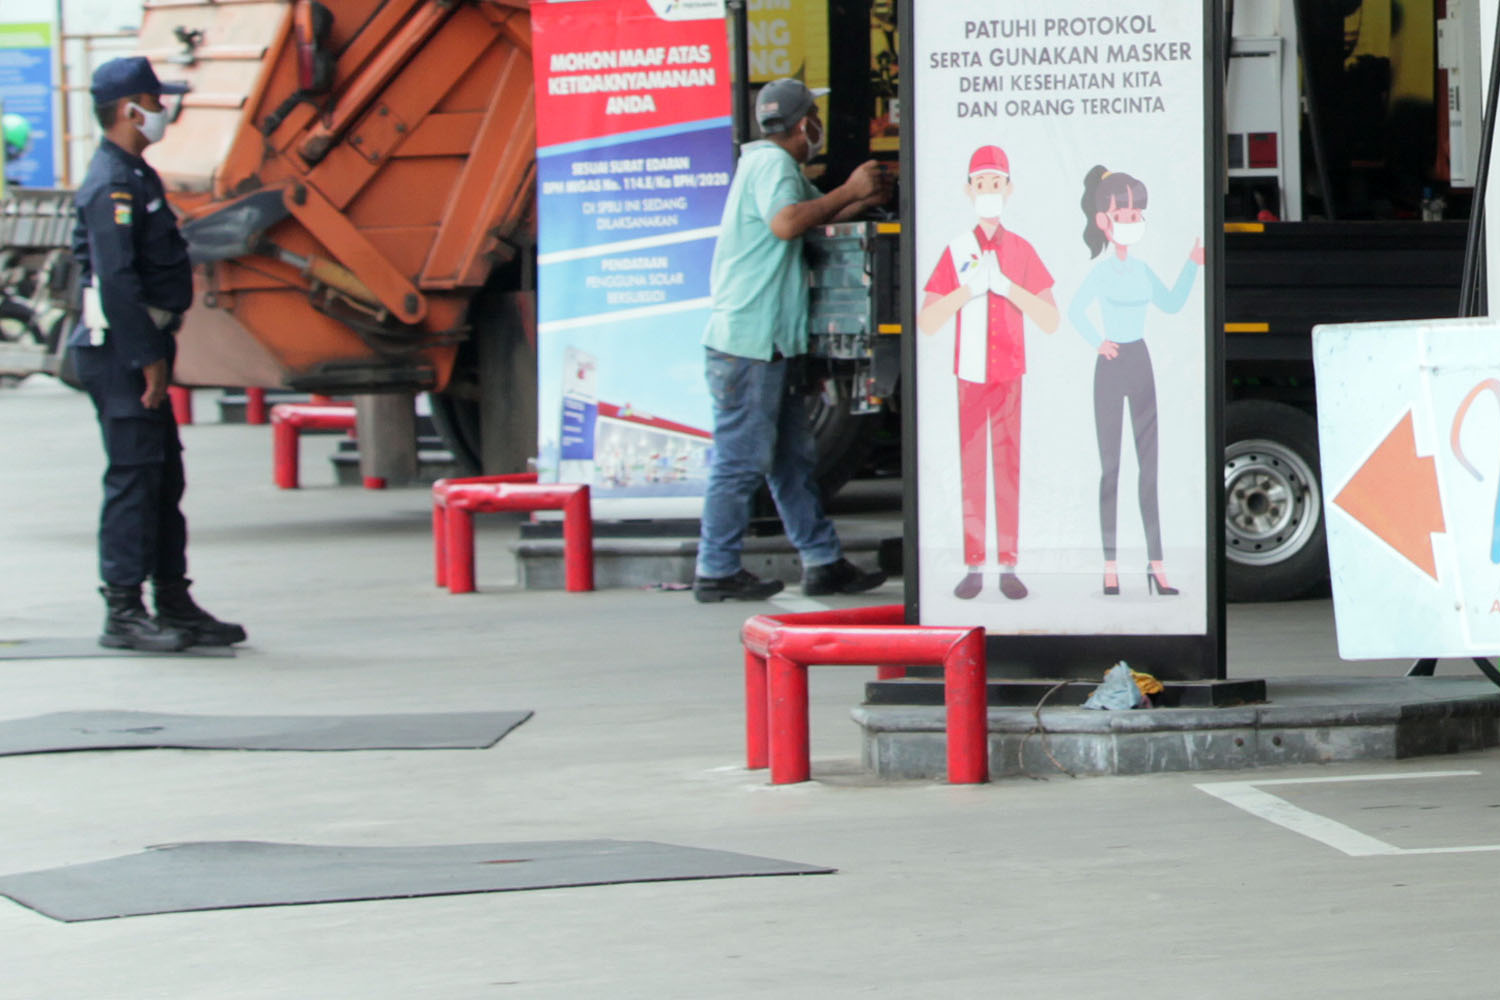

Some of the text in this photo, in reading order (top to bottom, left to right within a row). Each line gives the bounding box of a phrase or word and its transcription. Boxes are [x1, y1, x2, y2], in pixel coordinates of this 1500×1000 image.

[965, 15, 1156, 39] PATUHI PROTOKOL
[550, 44, 711, 72] MOHON MAAF ATAS
[930, 42, 1192, 69] SERTA GUNAKAN MASKER
[548, 68, 715, 95] KETIDAKNYAMANAN
[960, 71, 1162, 93] DEMI KESEHATAN KITA
[606, 94, 656, 115] ANDA
[957, 96, 1165, 118] DAN ORANG TERCINTA
